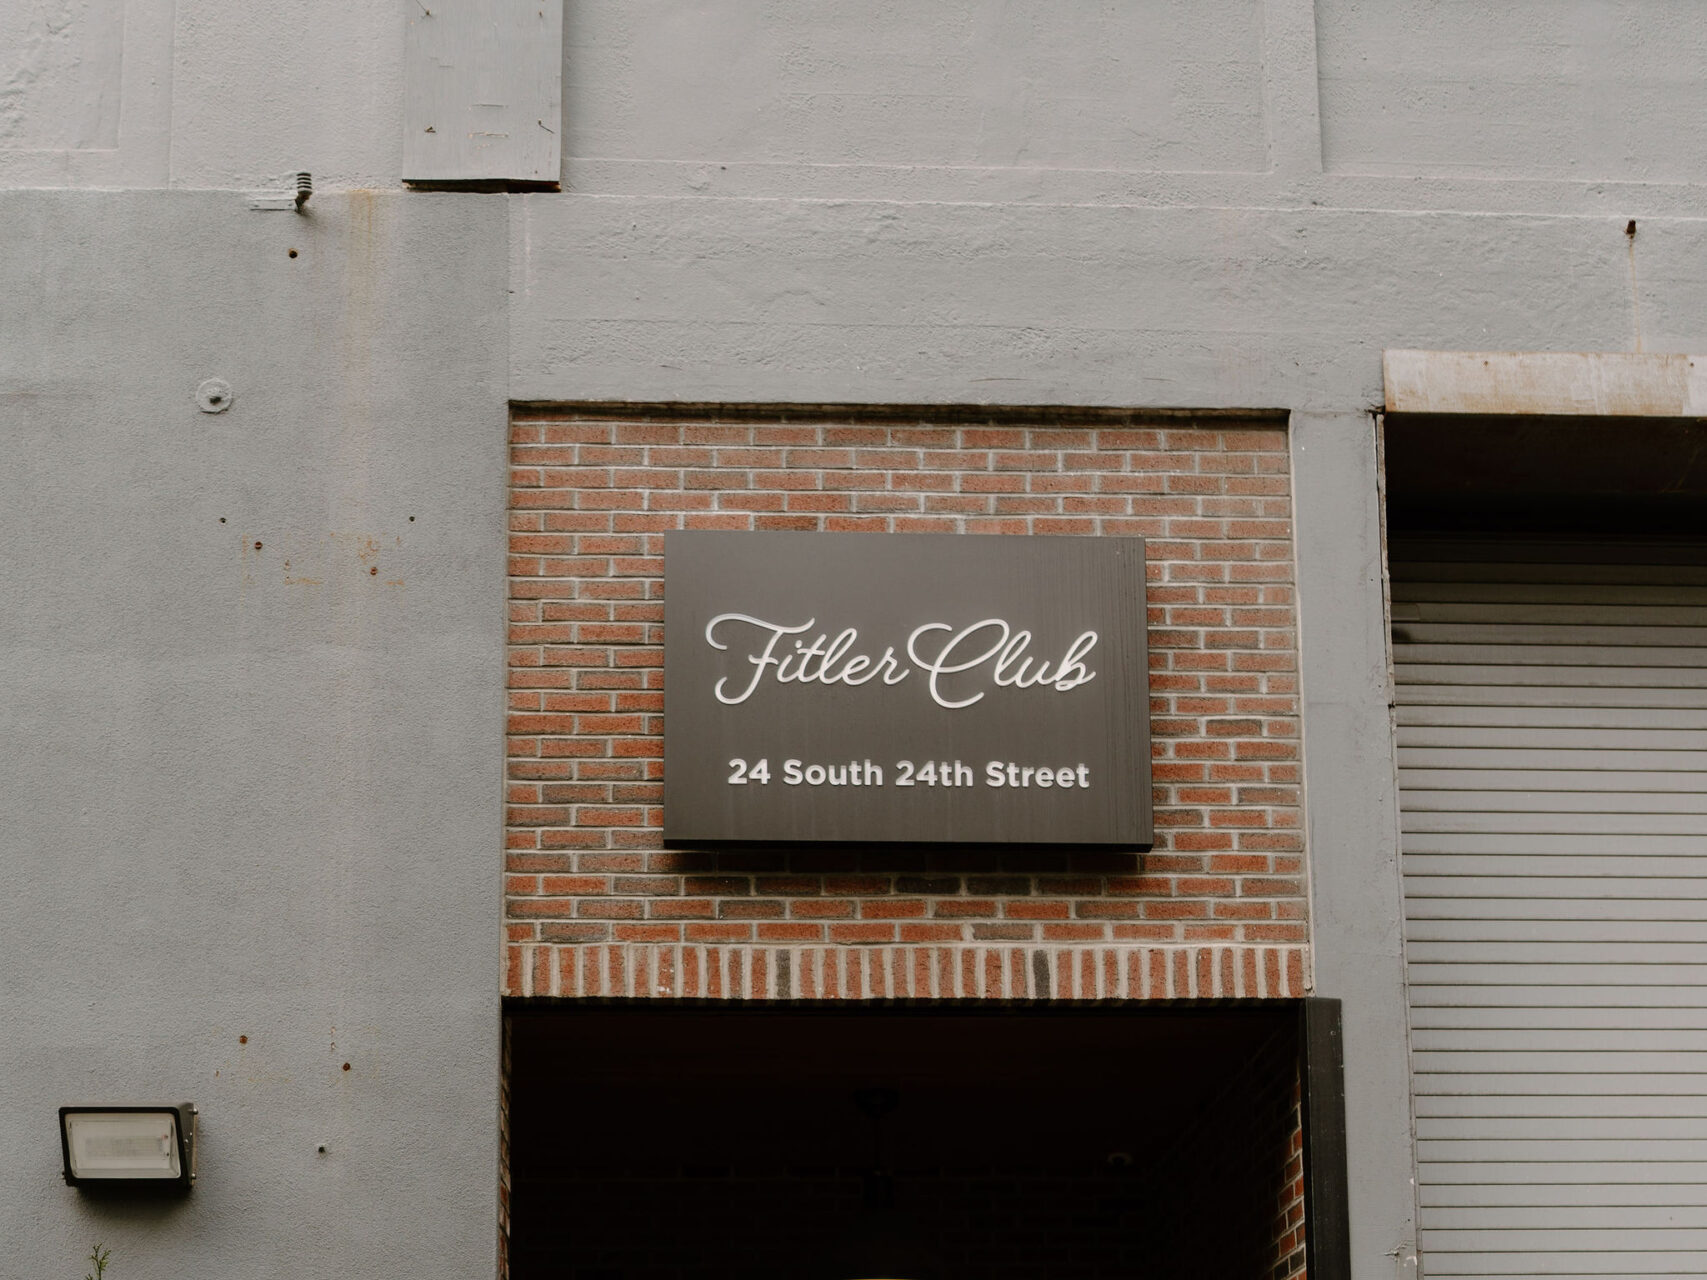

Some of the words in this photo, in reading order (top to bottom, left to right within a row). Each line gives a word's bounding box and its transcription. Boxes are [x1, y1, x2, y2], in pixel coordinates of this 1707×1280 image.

[705, 613, 909, 705] Fitler
[907, 618, 1098, 709] Club
[727, 758, 771, 786] 24
[783, 758, 884, 787] South
[895, 759, 974, 788] 24th
[985, 761, 1090, 789] Street
